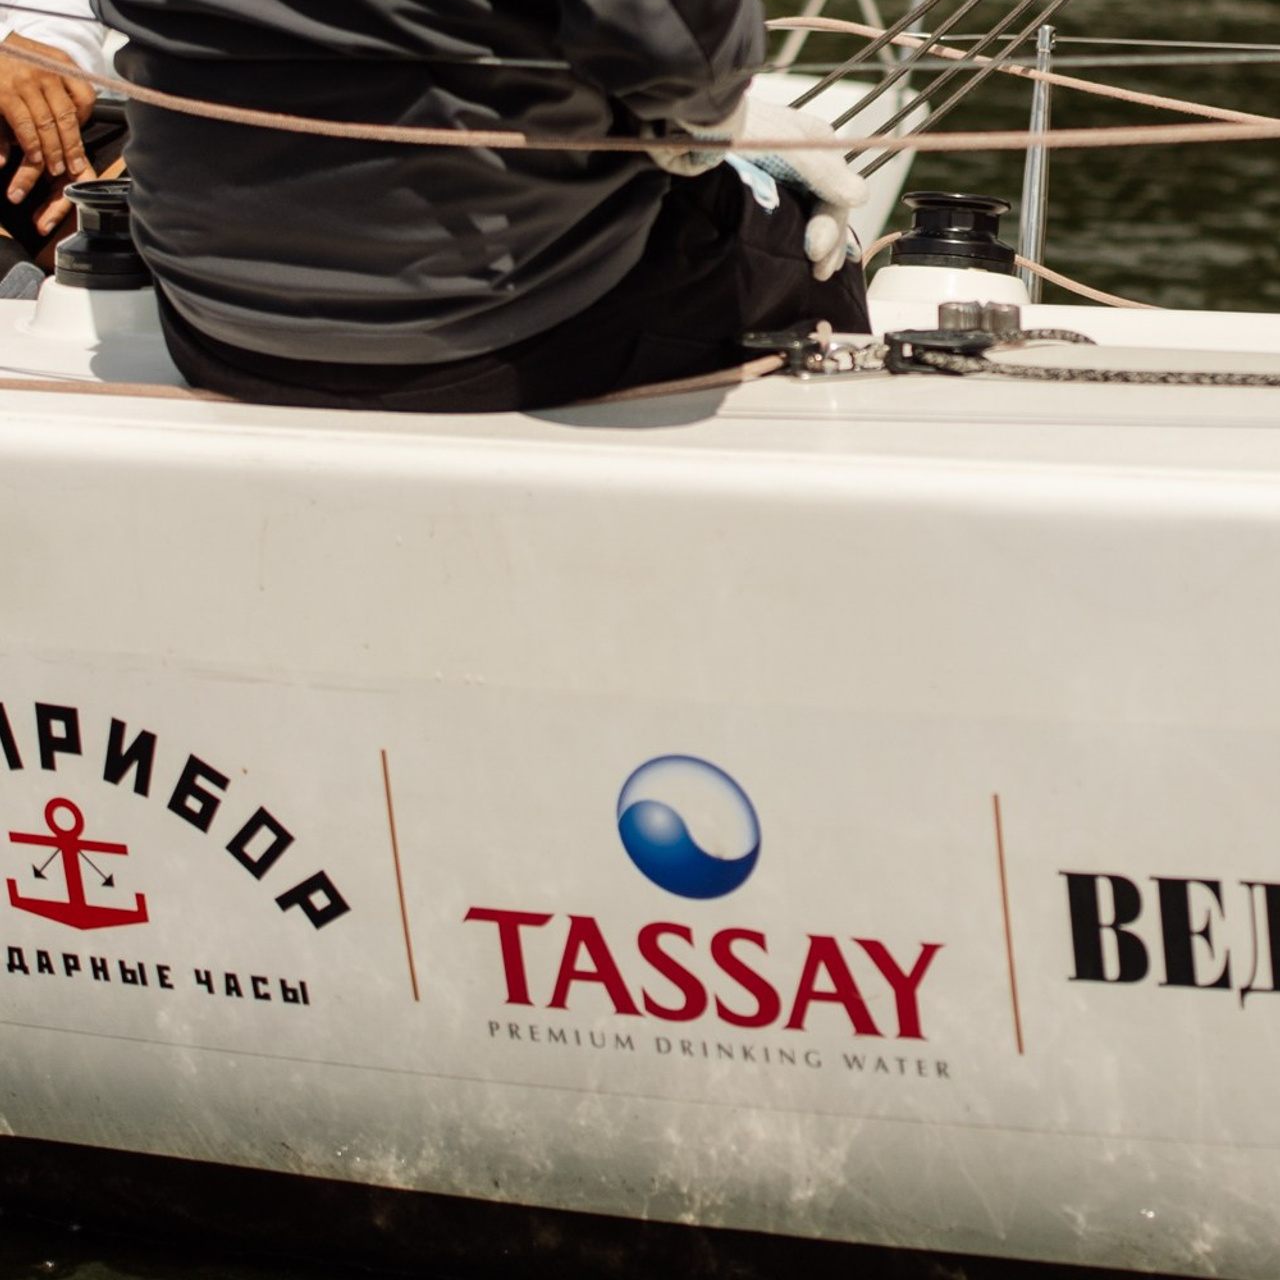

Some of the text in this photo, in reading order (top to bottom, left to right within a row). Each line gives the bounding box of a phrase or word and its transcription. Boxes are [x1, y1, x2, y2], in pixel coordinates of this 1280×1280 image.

[7, 946, 311, 1006] ДАРНЫЕ ЧАСЫ
[463, 906, 946, 1041] TASSAY
[488, 1020, 952, 1080] PREMIUM DRINKING WATER
